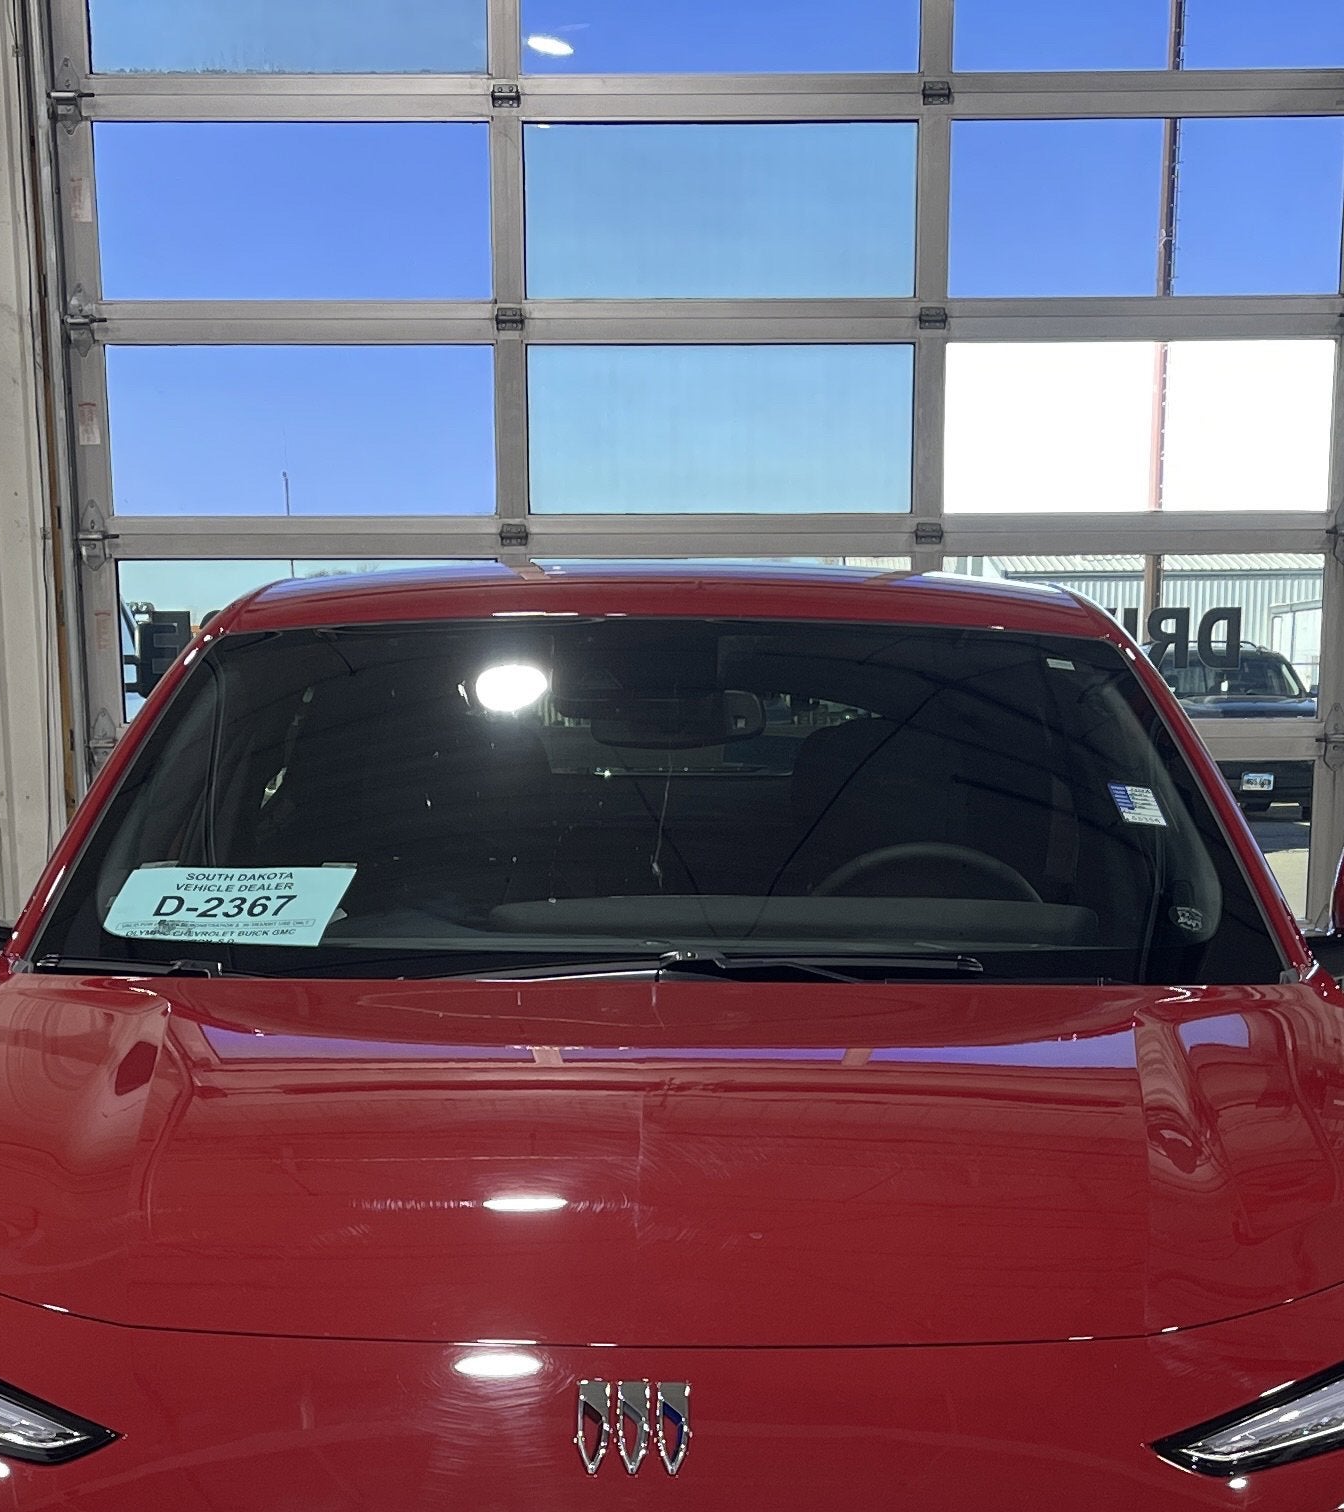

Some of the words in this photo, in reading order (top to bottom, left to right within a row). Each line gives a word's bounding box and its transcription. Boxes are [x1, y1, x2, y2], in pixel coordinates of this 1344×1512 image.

[185, 872, 234, 882] SOUTH
[237, 872, 294, 881] DAKOTA
[175, 883, 235, 892] VEHICLE
[239, 882, 295, 891] DEALER
[152, 895, 297, 918] D-2367
[237, 929, 270, 937] BUICK
[272, 928, 297, 936] GMC
